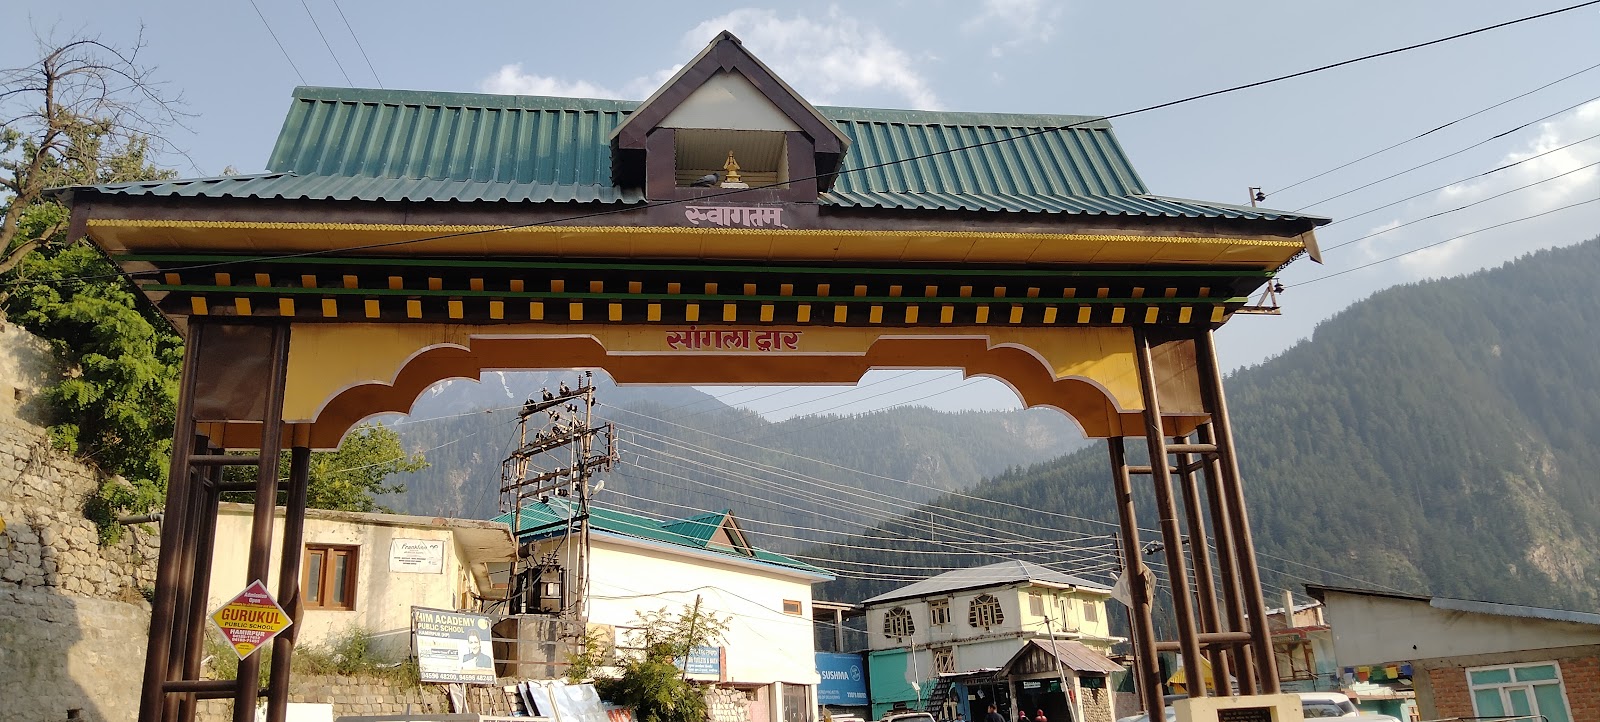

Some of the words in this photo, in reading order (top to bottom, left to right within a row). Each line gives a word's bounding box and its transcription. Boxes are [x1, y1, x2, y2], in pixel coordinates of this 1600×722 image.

[685, 205, 788, 228] स्वागतम्
[666, 326, 752, 351] सांगला
[755, 330, 802, 352] द्वार
[222, 608, 280, 624] GURUKUL
[435, 615, 475, 626] ACADEMY
[230, 629, 265, 637] HAMIRPUR
[418, 623, 439, 631] PUBLIC
[440, 625, 465, 633] SCHOOL
[821, 671, 849, 680] SUSHMA
